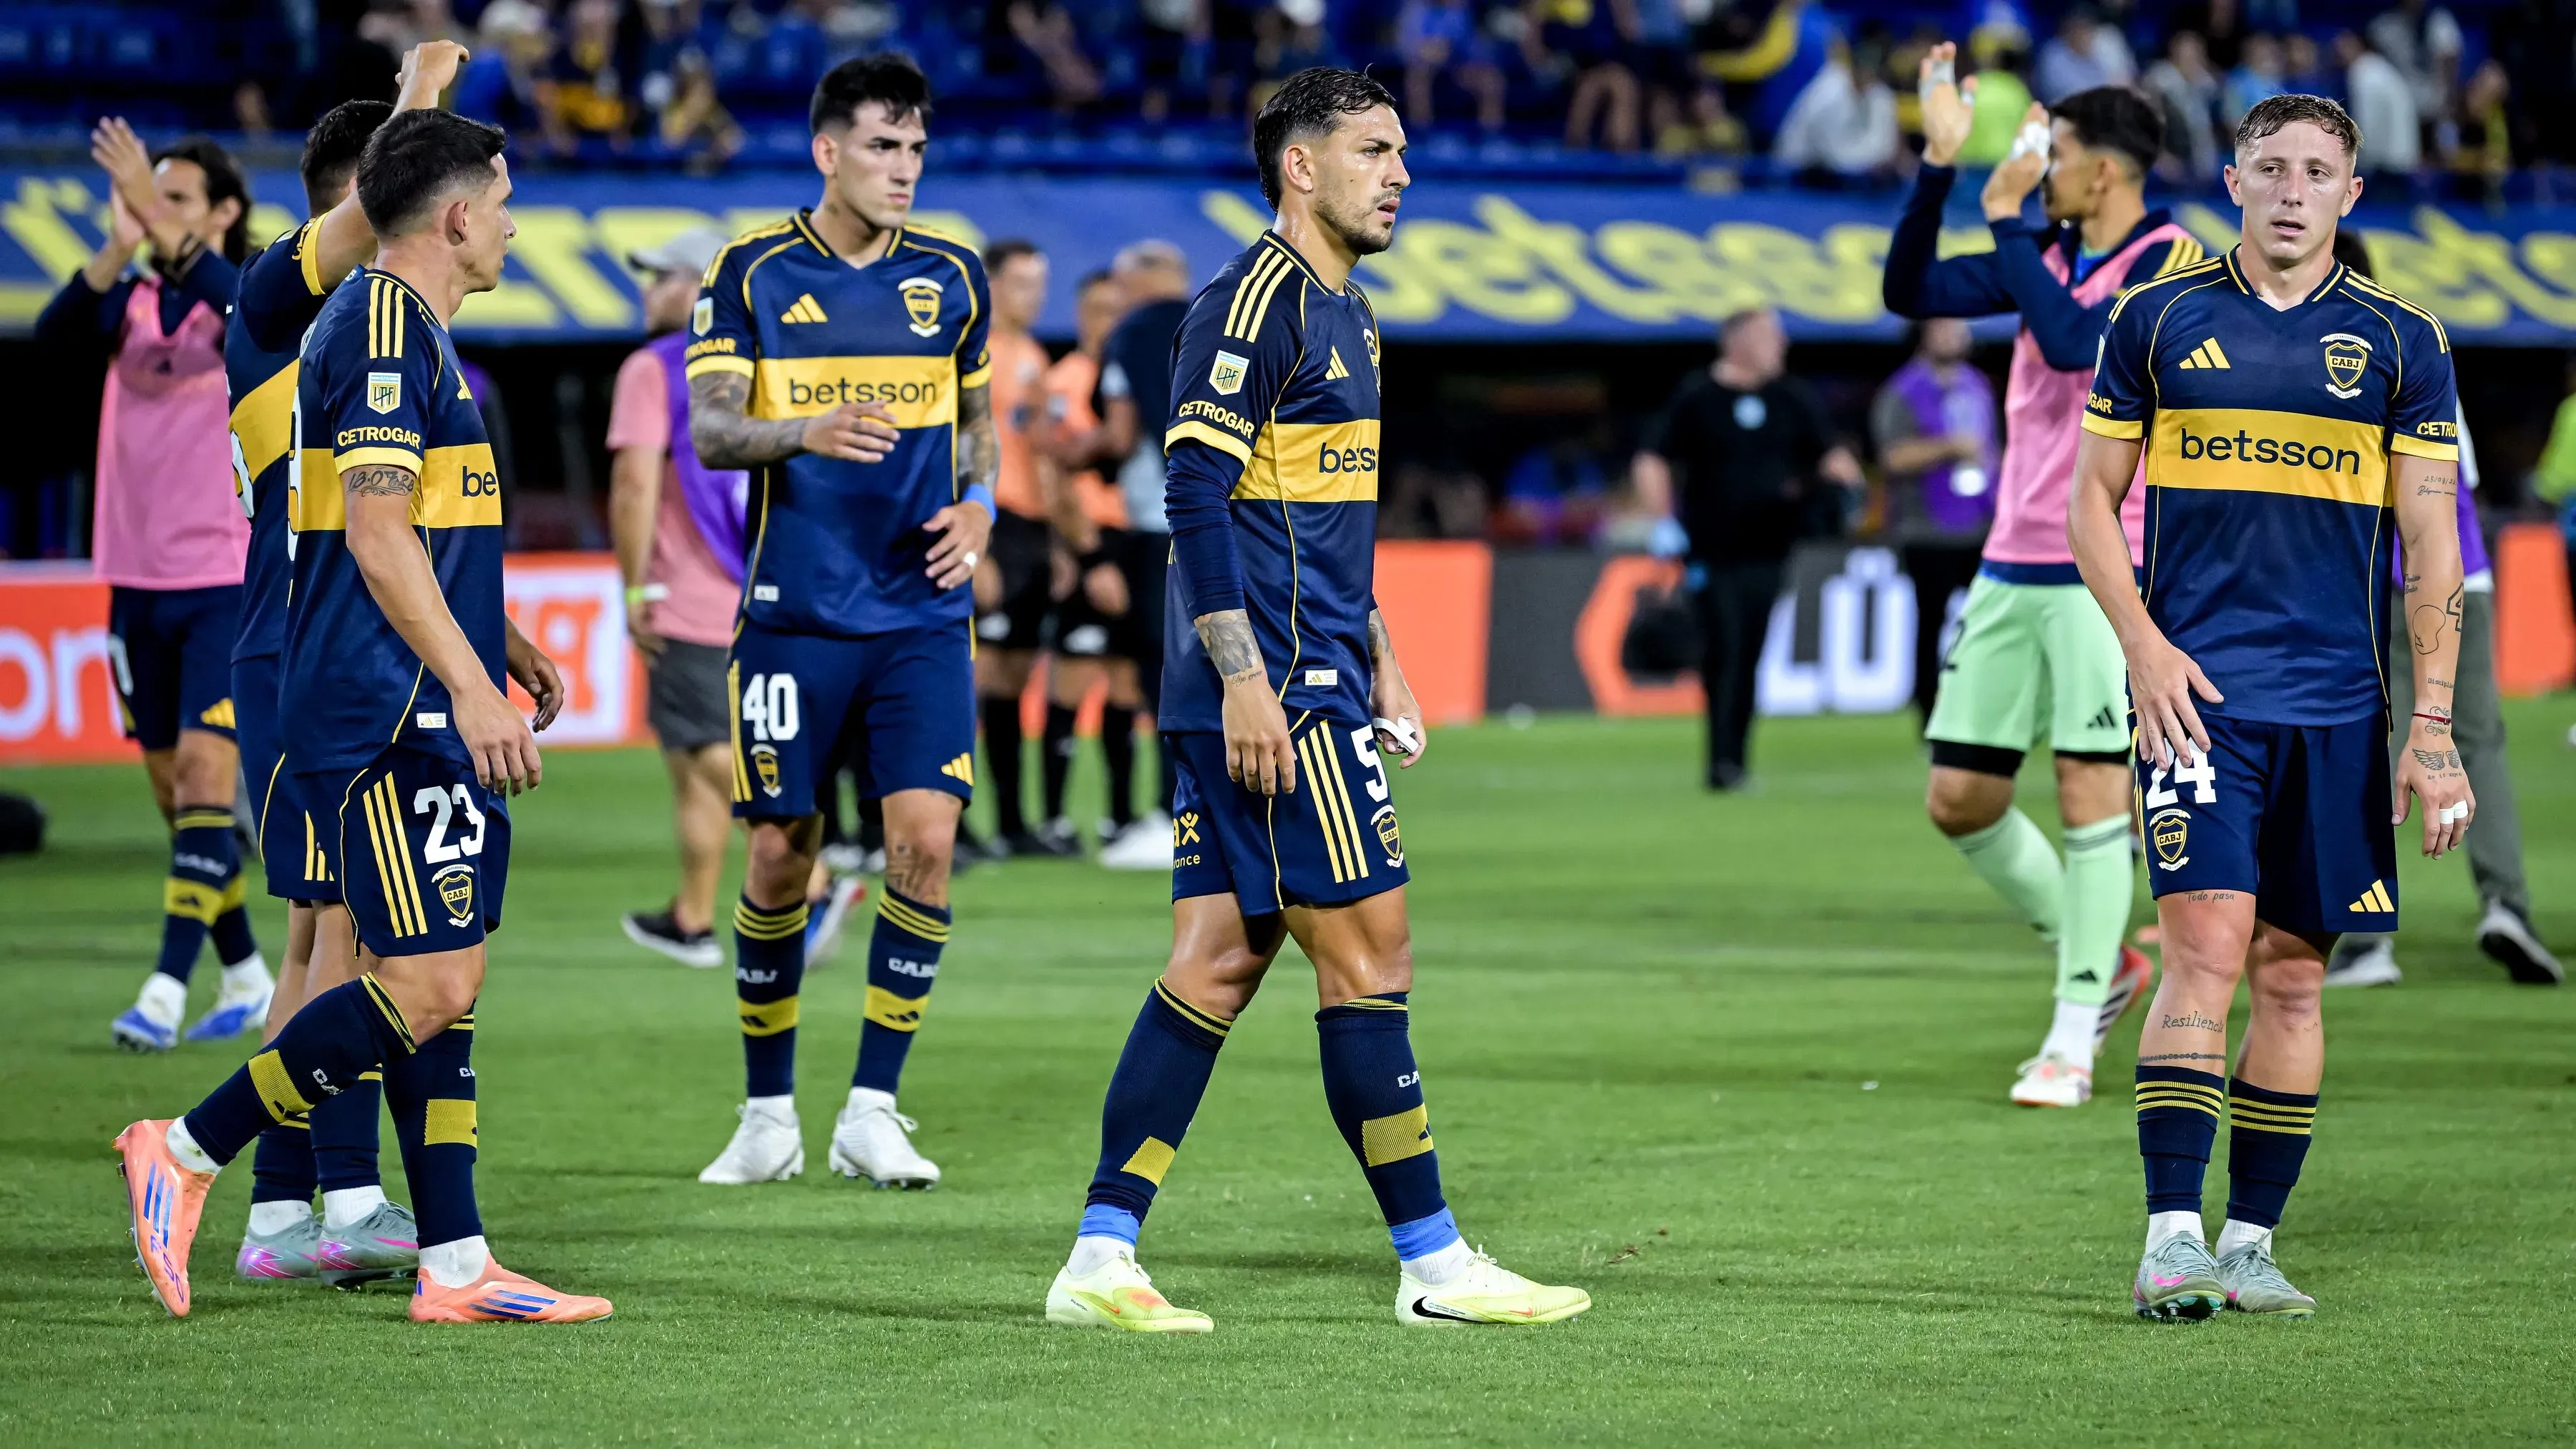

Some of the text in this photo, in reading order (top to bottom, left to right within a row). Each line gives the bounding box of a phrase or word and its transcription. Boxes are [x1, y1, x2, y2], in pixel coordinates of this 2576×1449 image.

[2332, 358, 2359, 368] CABJ
[790, 378, 936, 405] betsson
[1179, 401, 1255, 439] CETROGAR
[337, 426, 421, 449] CETROGAR
[2181, 428, 2360, 475] betsson
[742, 673, 800, 741] 40
[1350, 723, 1389, 803] 5
[2146, 737, 2217, 810] 24
[414, 784, 485, 864] 23
[1382, 829, 1397, 841] CABJ
[2159, 833, 2181, 844] CABJ
[447, 888, 468, 900] CABJ
[2185, 891, 2235, 904] Todo pasa
